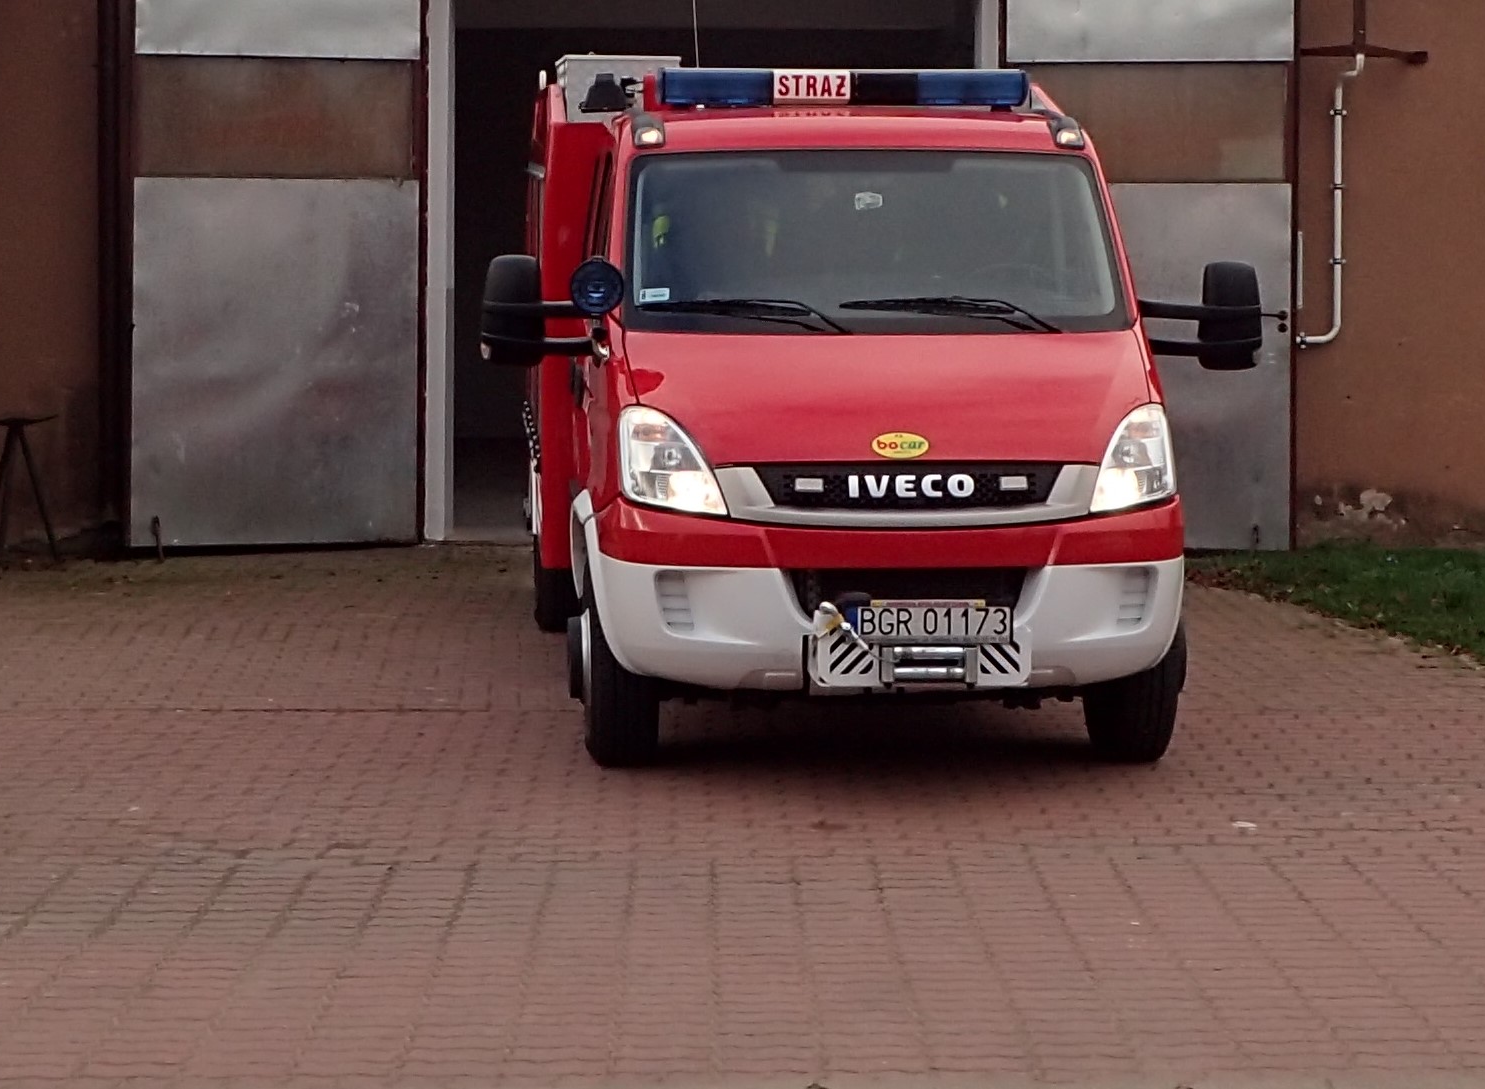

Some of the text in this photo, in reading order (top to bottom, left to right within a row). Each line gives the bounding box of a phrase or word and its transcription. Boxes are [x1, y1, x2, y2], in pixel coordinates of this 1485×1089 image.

[847, 473, 975, 498] IVECO
[860, 608, 1007, 635] BGR 01173
